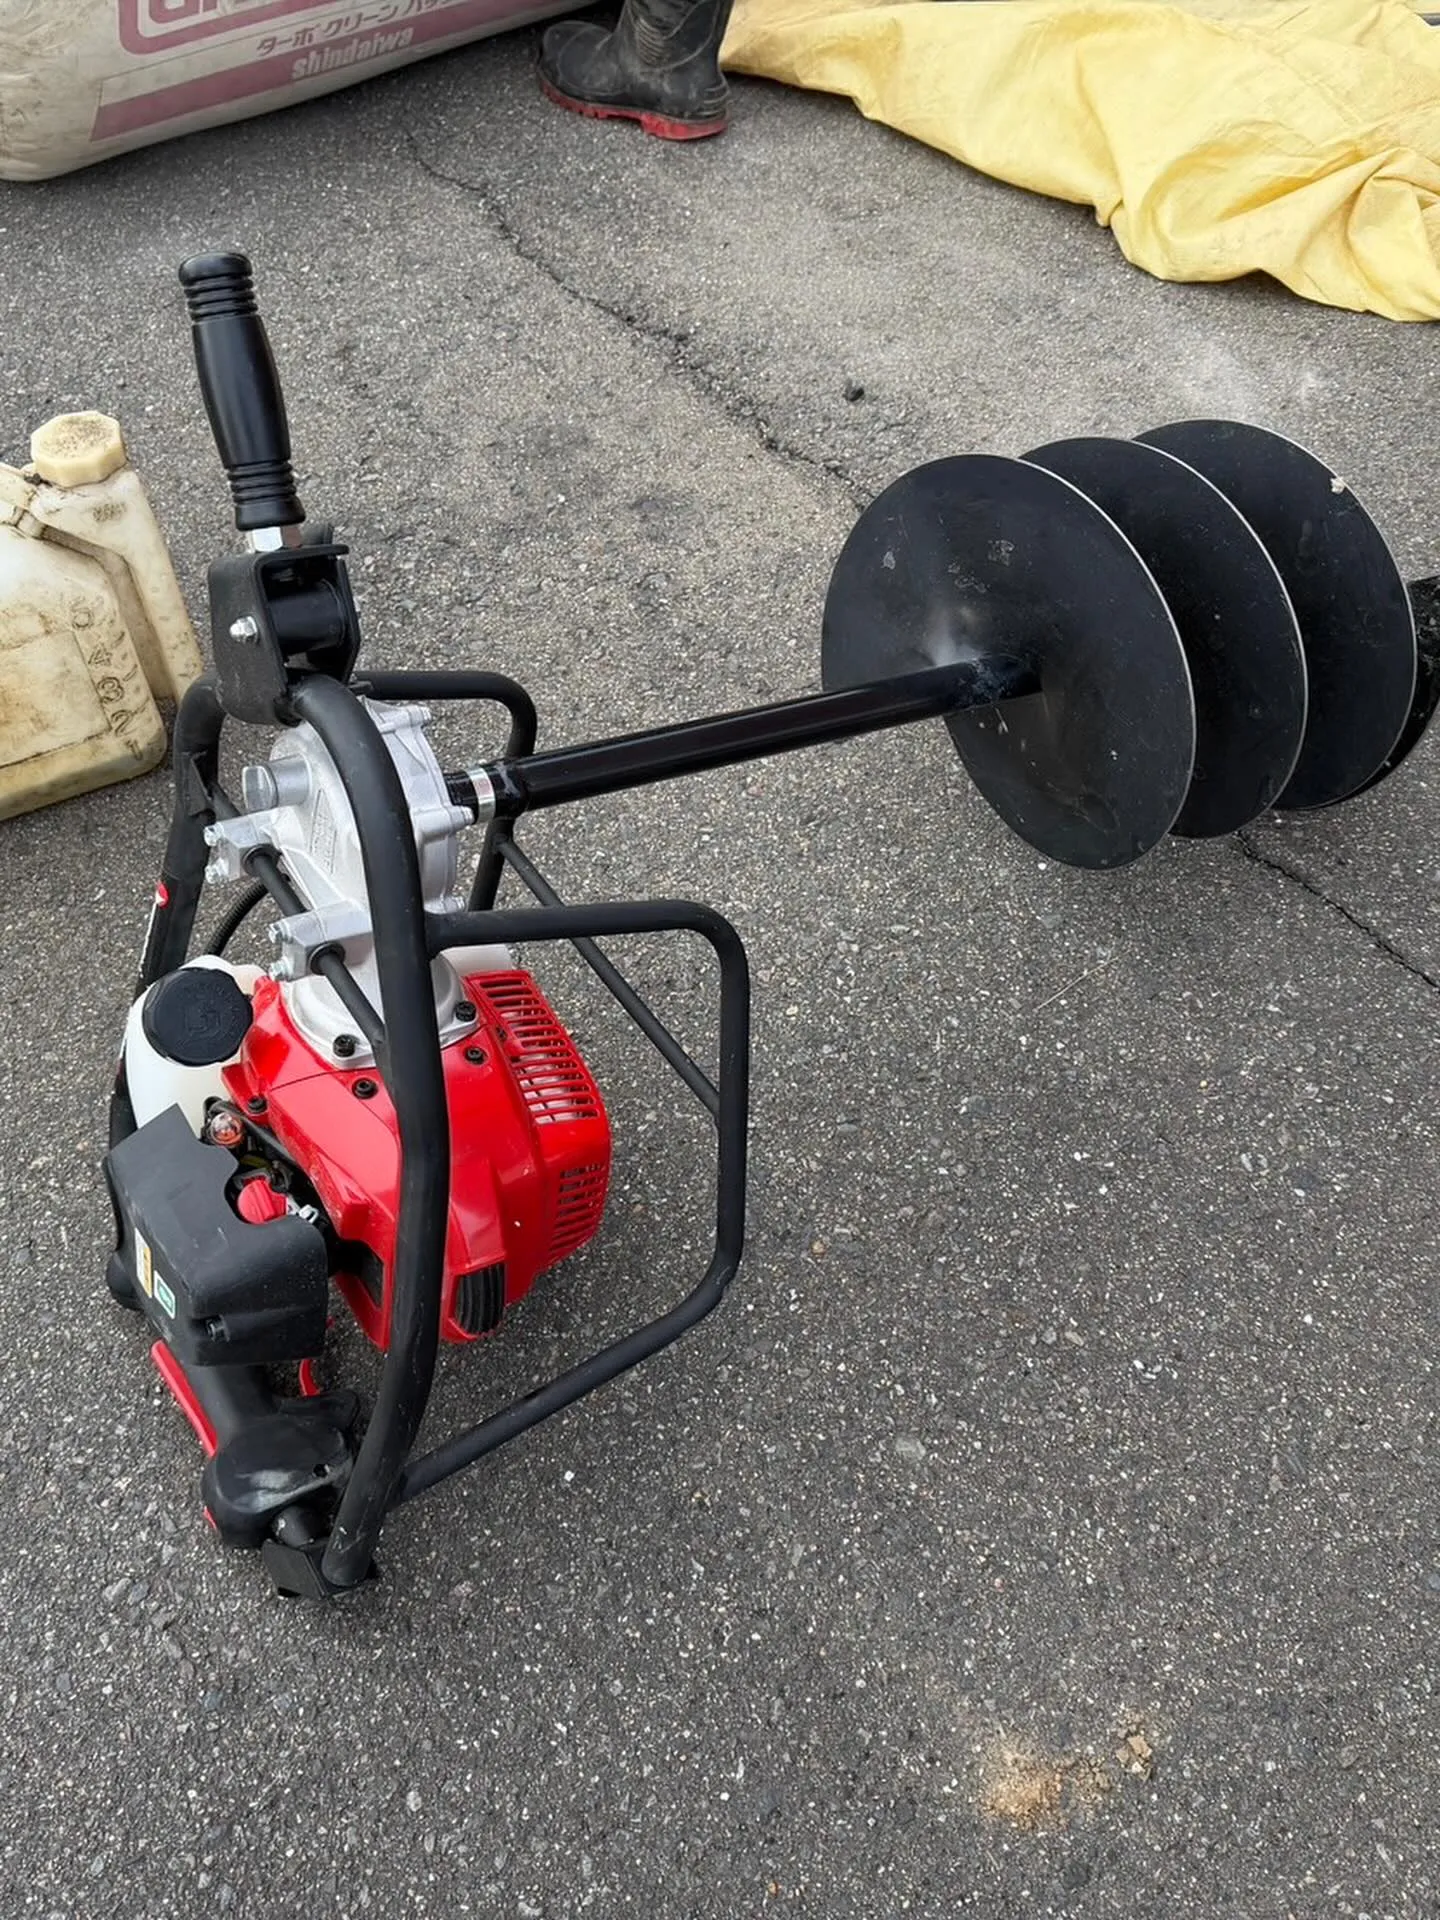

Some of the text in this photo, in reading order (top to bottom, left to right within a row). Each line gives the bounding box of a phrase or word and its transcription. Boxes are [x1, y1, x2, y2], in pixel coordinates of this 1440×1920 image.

[291, 27, 414, 80] shindaiwa
[88, 643, 113, 667] 4
[97, 676, 125, 704] 3
[110, 709, 135, 737] 2
